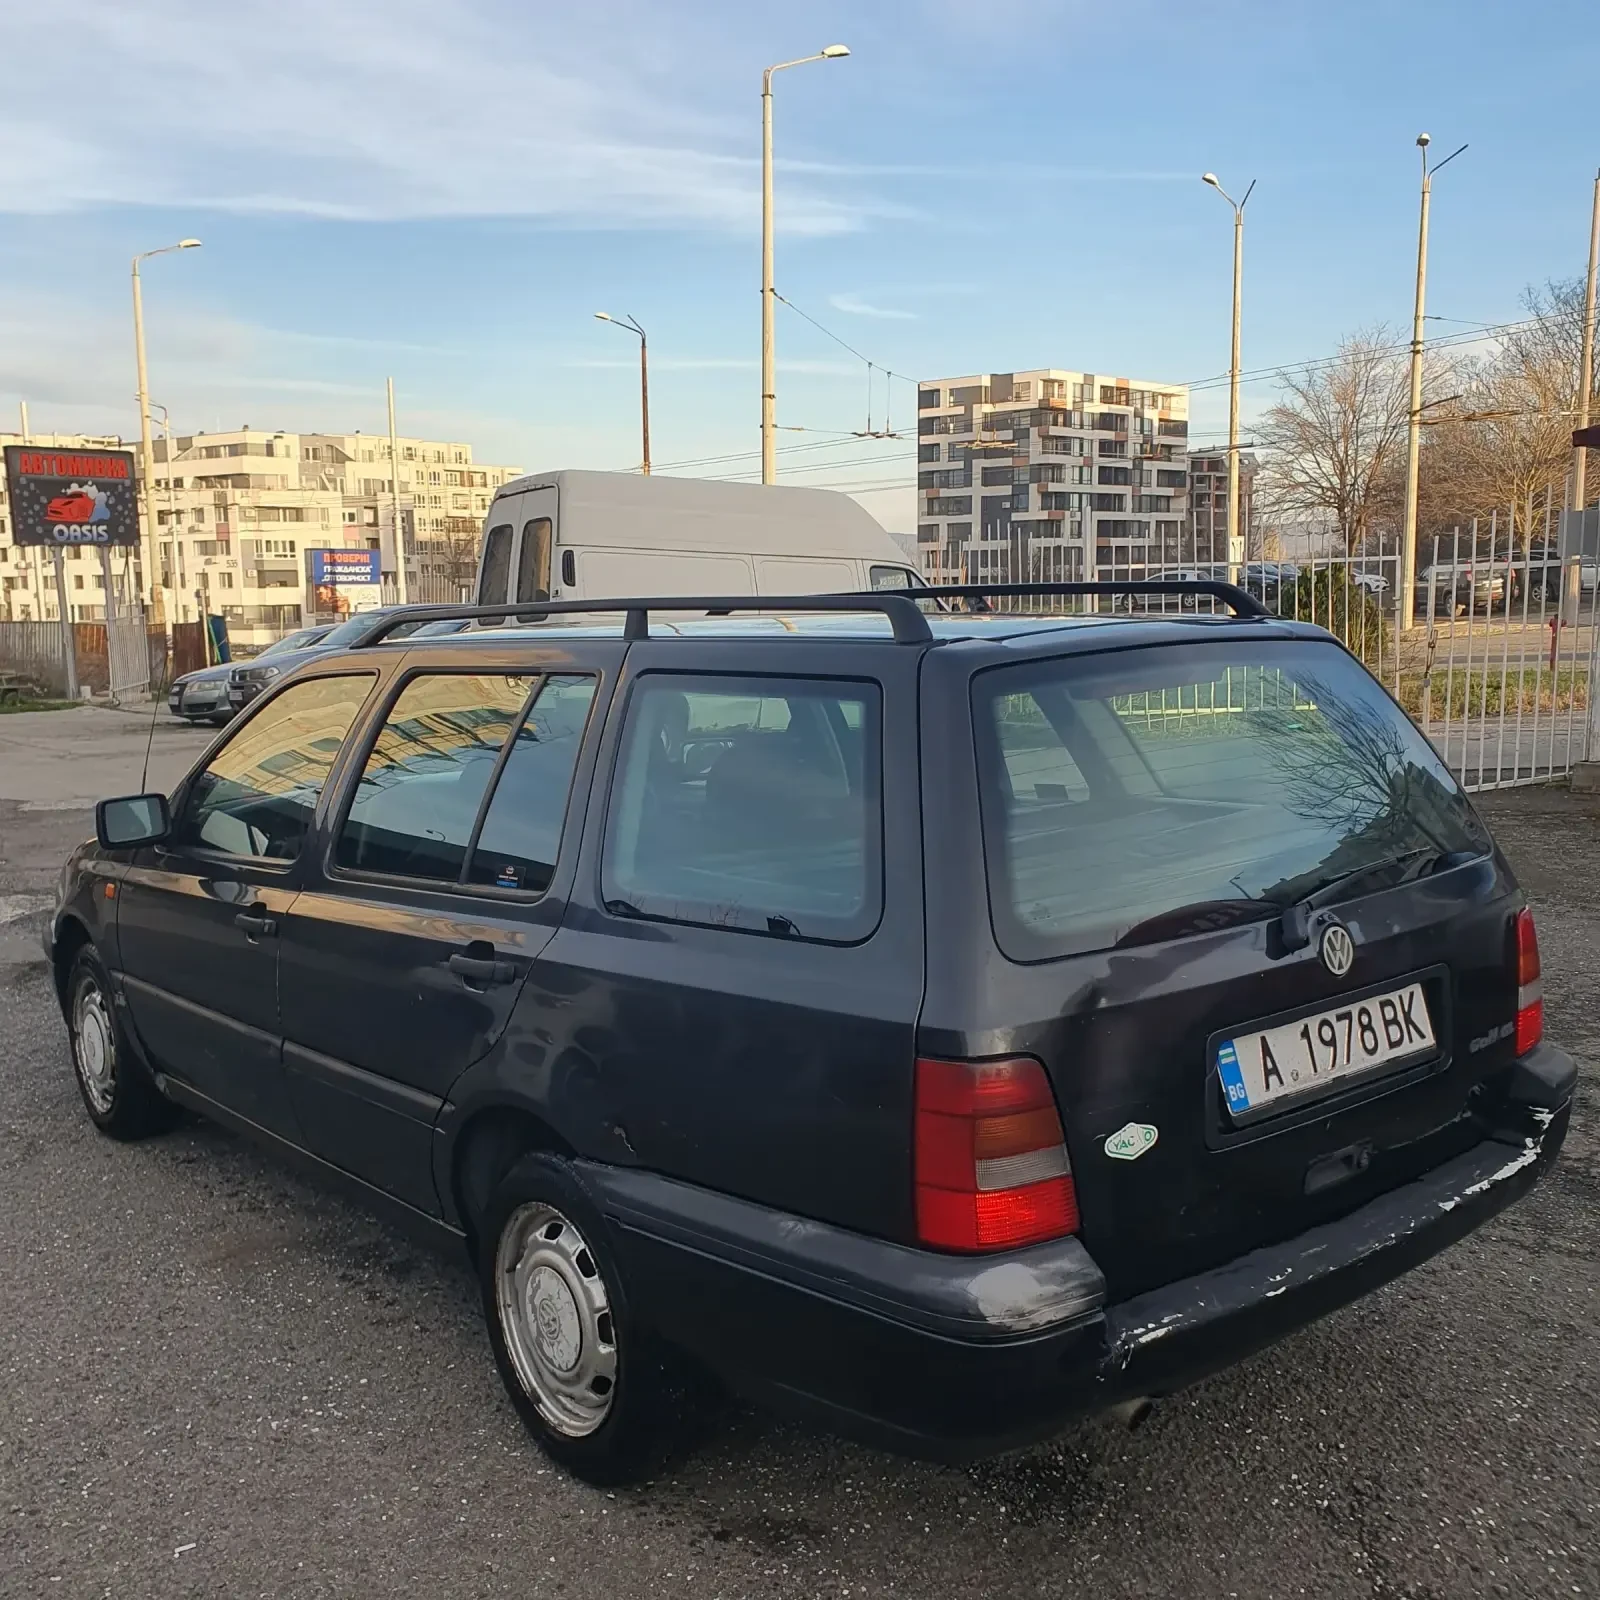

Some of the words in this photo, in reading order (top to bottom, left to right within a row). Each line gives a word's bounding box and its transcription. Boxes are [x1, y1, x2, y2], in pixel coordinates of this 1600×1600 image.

[20, 452, 128, 477] АВТОМИВКА
[53, 524, 109, 541] OASIS
[1300, 1008, 1379, 1074] 1978
[1228, 1083, 1245, 1102] BG
